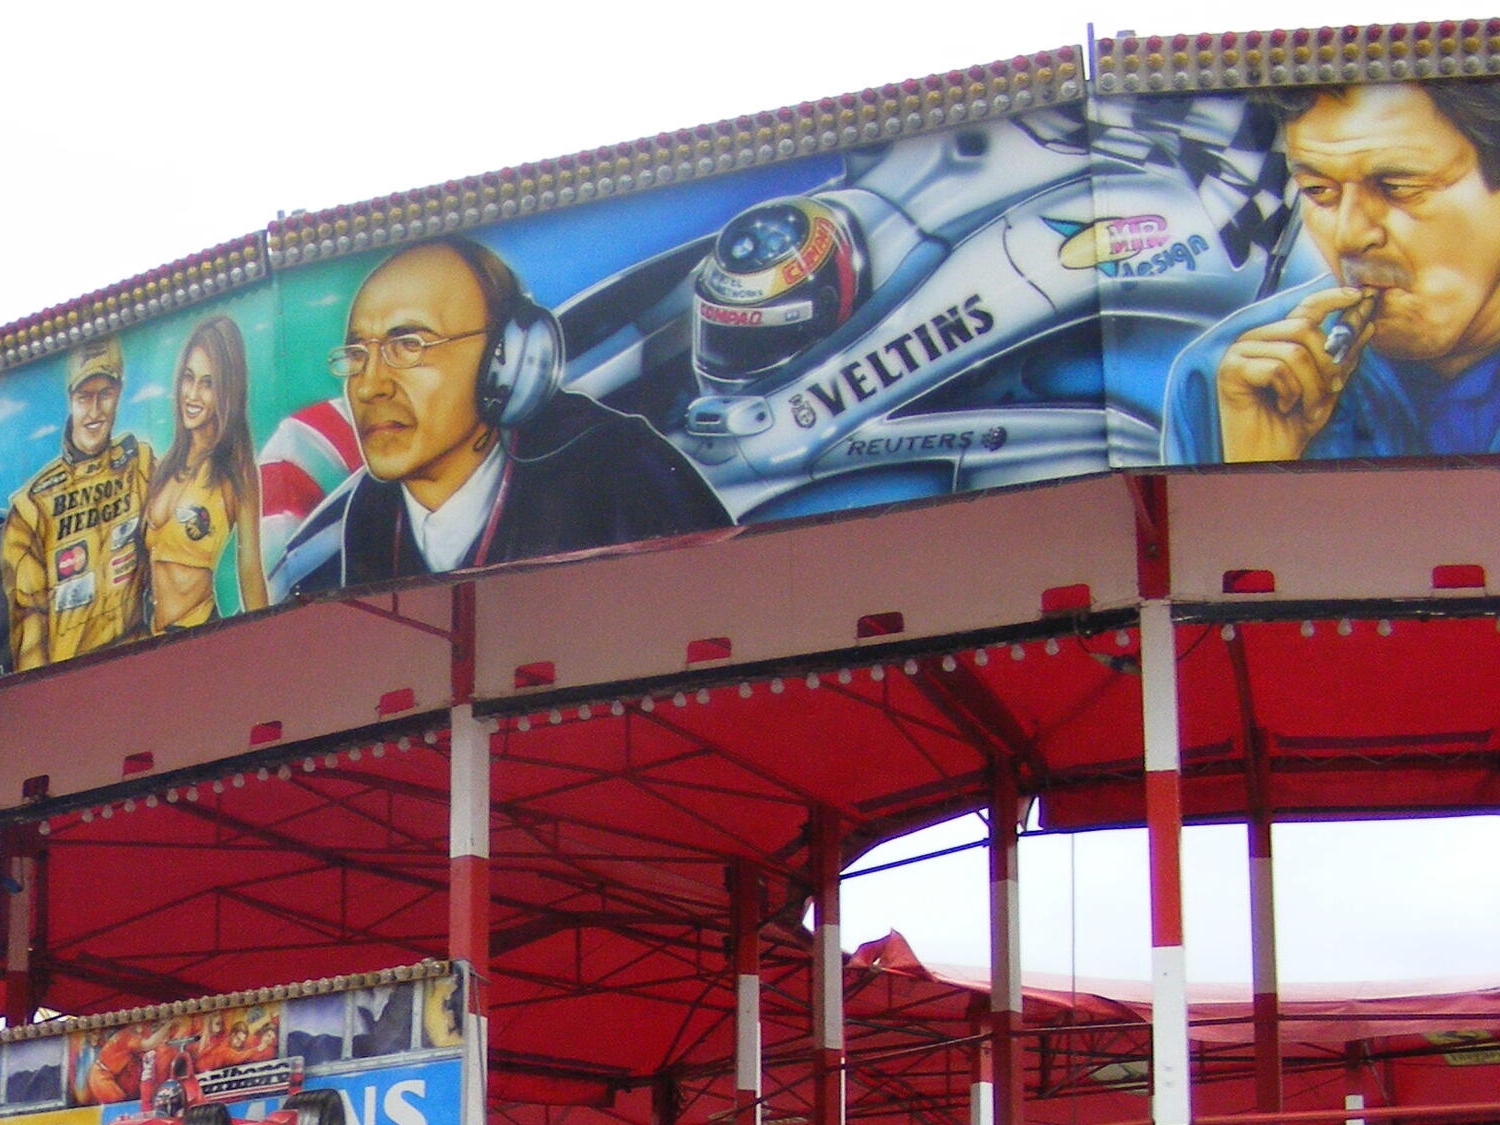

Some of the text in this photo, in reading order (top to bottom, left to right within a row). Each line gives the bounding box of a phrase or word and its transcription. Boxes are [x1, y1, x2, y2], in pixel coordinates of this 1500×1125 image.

[804, 293, 995, 418] VELTINS
[846, 430, 975, 457] REUTERS
[53, 479, 124, 517] BENSON
[56, 492, 132, 541] HEDGES
